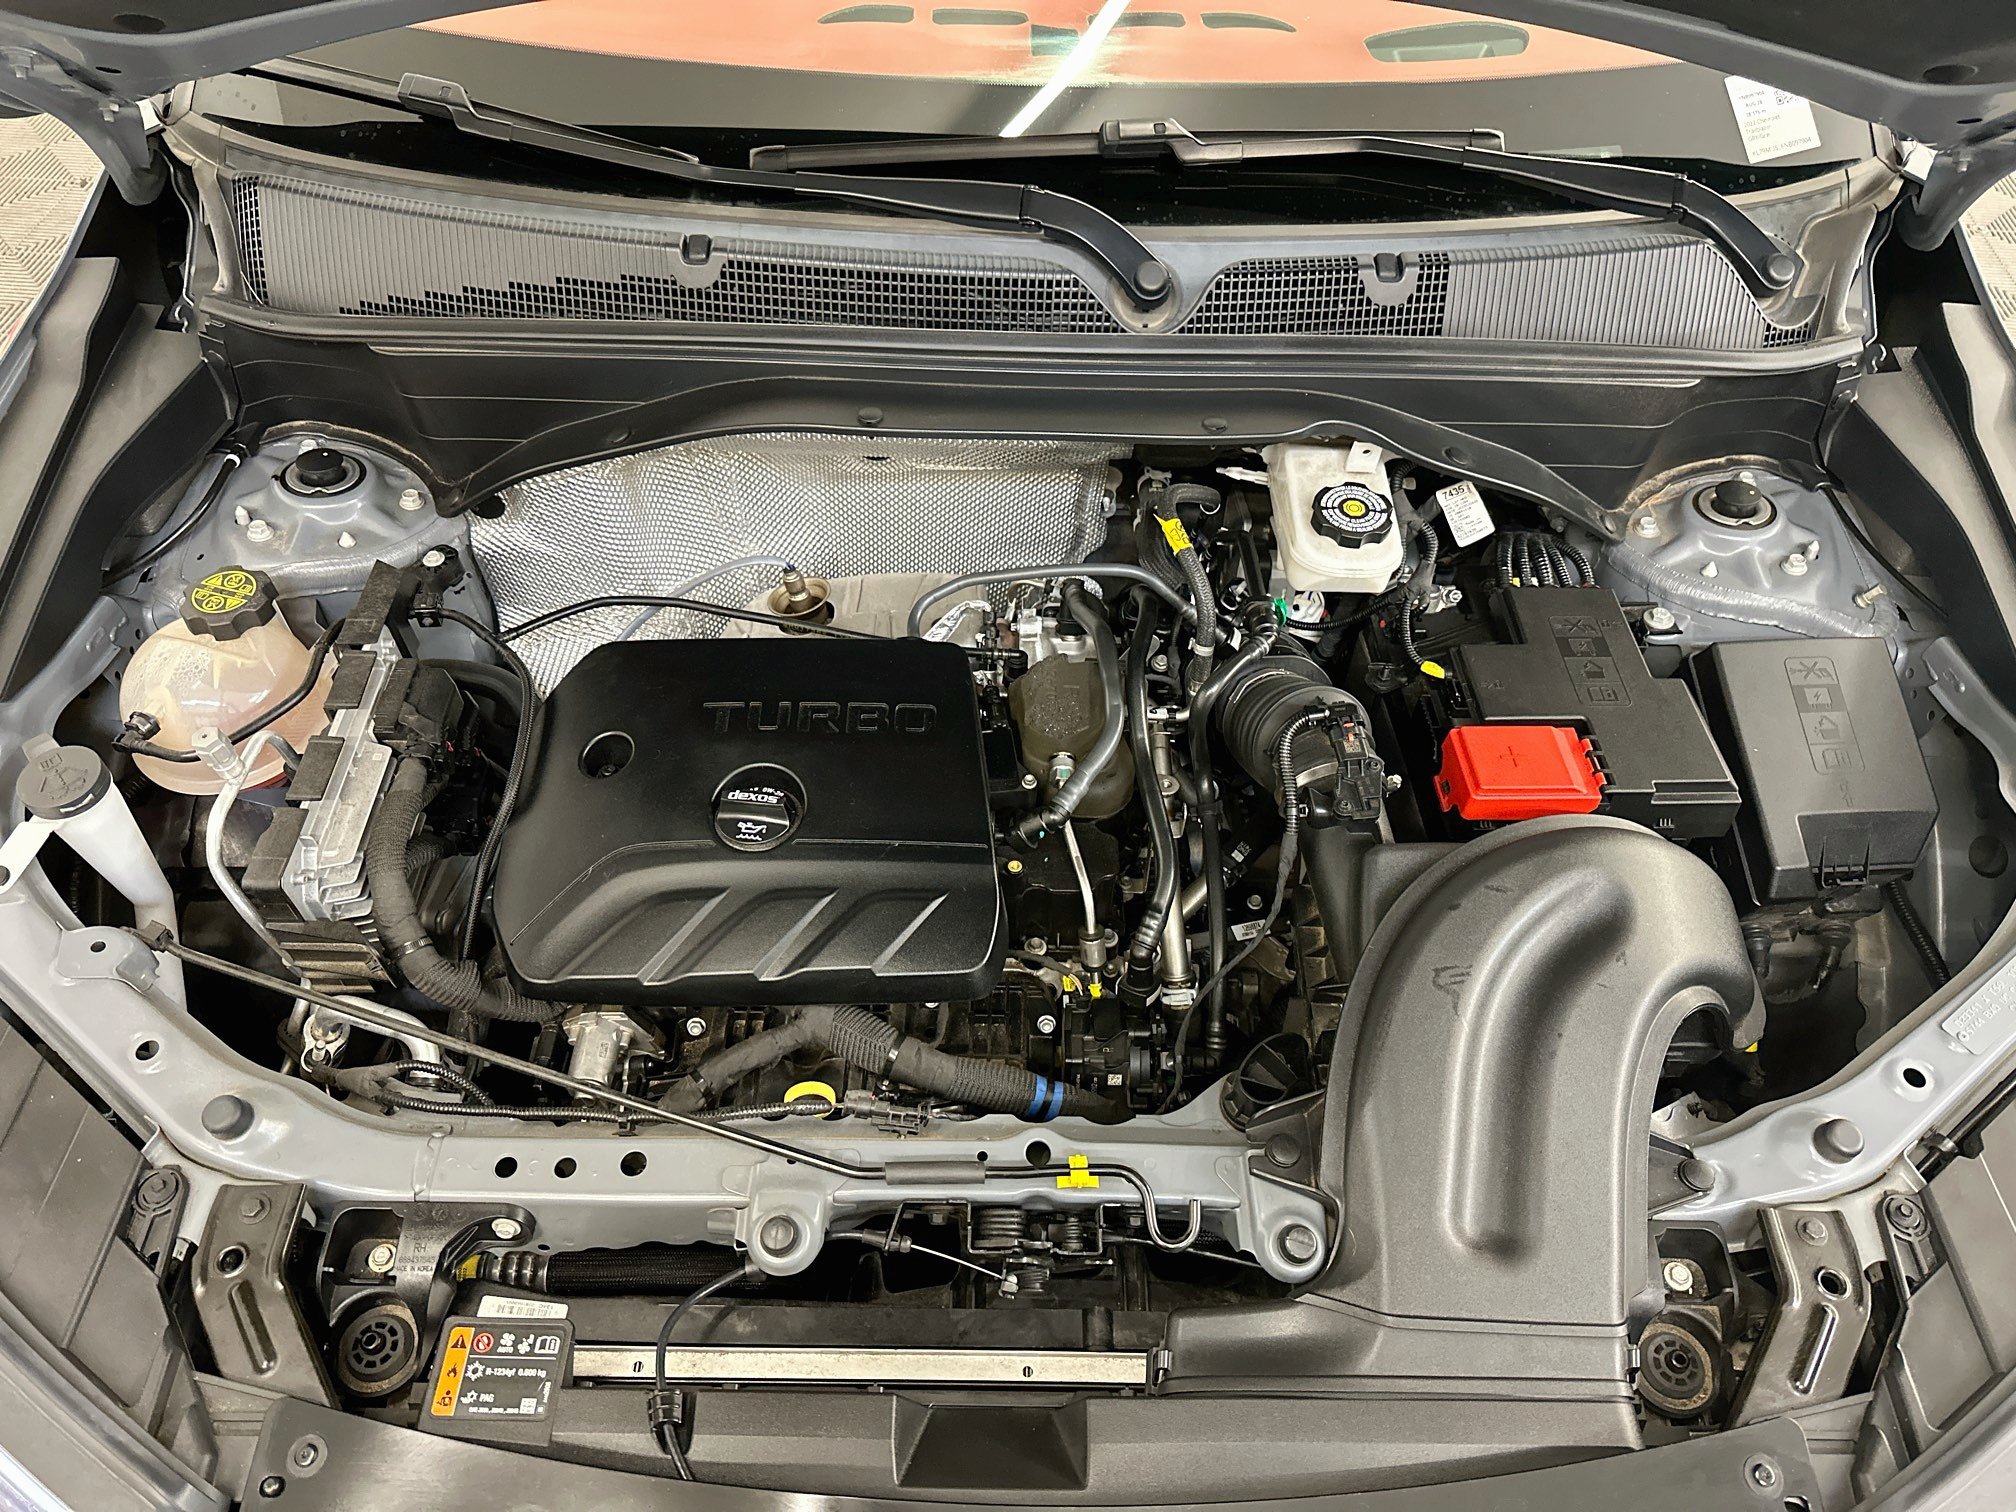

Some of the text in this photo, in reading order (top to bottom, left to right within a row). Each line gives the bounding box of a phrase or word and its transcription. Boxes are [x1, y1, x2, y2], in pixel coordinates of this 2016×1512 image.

[1441, 485, 1465, 499] 7435
[703, 701, 938, 733] TURBO
[727, 789, 779, 804] dexos
[413, 1242, 428, 1253] RH
[485, 1367, 516, 1378] R-1234yf
[479, 1393, 495, 1403] PAG
